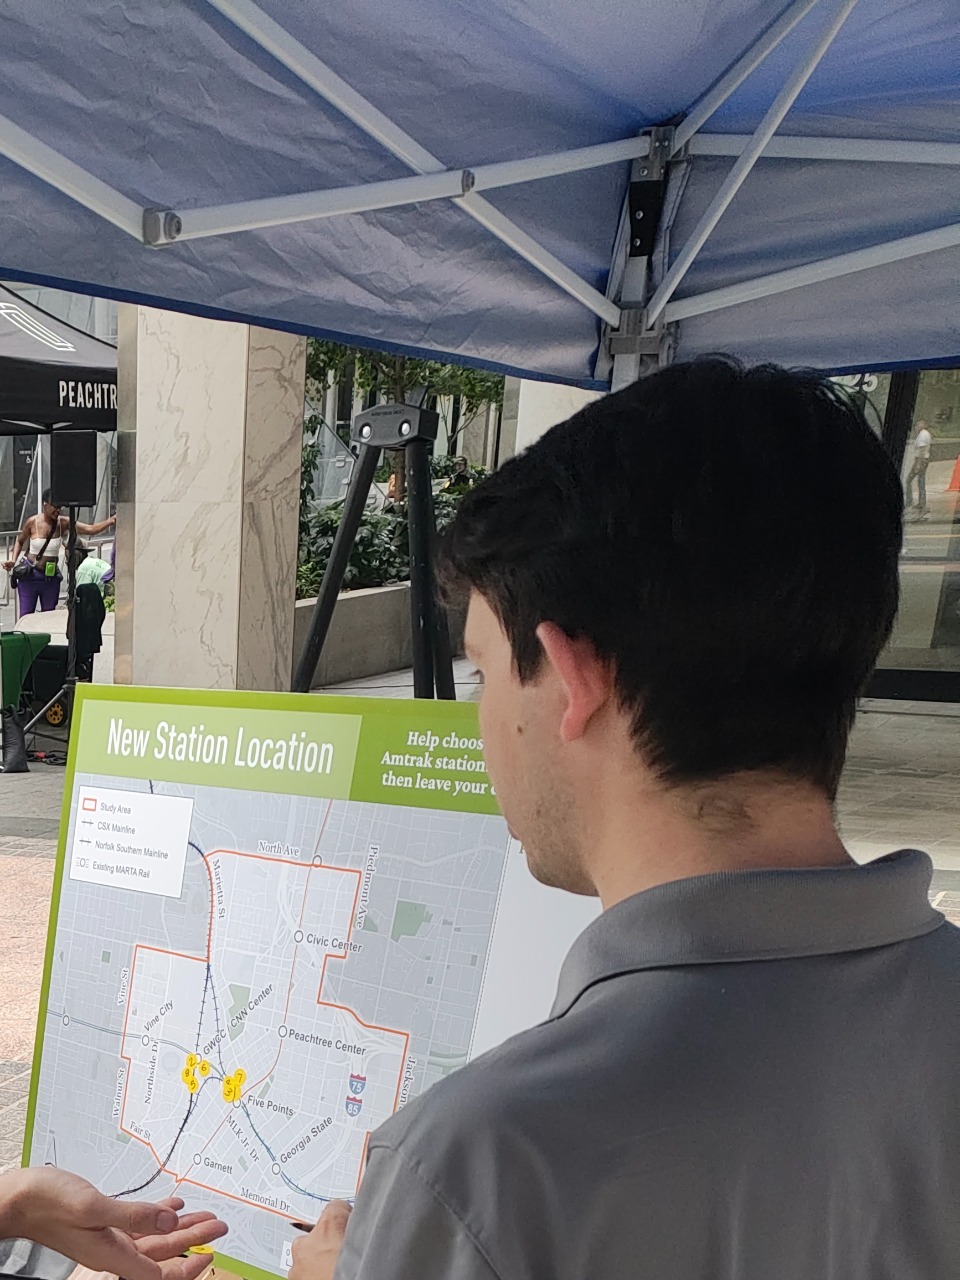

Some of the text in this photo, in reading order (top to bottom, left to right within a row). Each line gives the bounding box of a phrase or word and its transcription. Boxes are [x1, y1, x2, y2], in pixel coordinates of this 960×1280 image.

[59, 380, 117, 409] PEACHTR
[107, 717, 334, 774] New Station Location
[406, 730, 484, 751] Help choos
[380, 751, 433, 768] Amtrak
[381, 770, 412, 788] then
[415, 772, 451, 791] leave
[452, 779, 488, 796] your
[100, 802, 131, 815] Study Area
[97, 821, 135, 834] CSX Mainline
[95, 840, 168, 859] Norfolk Southern Mainline
[258, 841, 299, 857] North Ave
[93, 861, 150, 879] Existing MARTA Rail
[212, 859, 226, 919] Marietta St
[356, 844, 379, 928] Piedmont Ave
[306, 934, 363, 953] Civic Center
[118, 967, 129, 1005] Vine St
[144, 1000, 174, 1032] Vine City
[230, 1009, 248, 1029] CNN
[248, 983, 274, 1011] Center
[289, 1028, 367, 1056] Peachtree Center
[144, 1055, 158, 1105] Northside
[237, 1073, 243, 1083] 7
[351, 1081, 362, 1093] 75
[399, 1056, 415, 1103] Jackson
[113, 1068, 125, 1118] Walnut St
[247, 1094, 294, 1117] Five Points
[347, 1103, 359, 1115] 85
[129, 1120, 152, 1141] Fair St
[226, 1115, 244, 1139] MLK
[249, 1148, 260, 1162] Dr
[280, 1116, 333, 1164] Georgia State
[203, 1156, 233, 1175] Garnett
[240, 1187, 291, 1213] Memorial Dr
